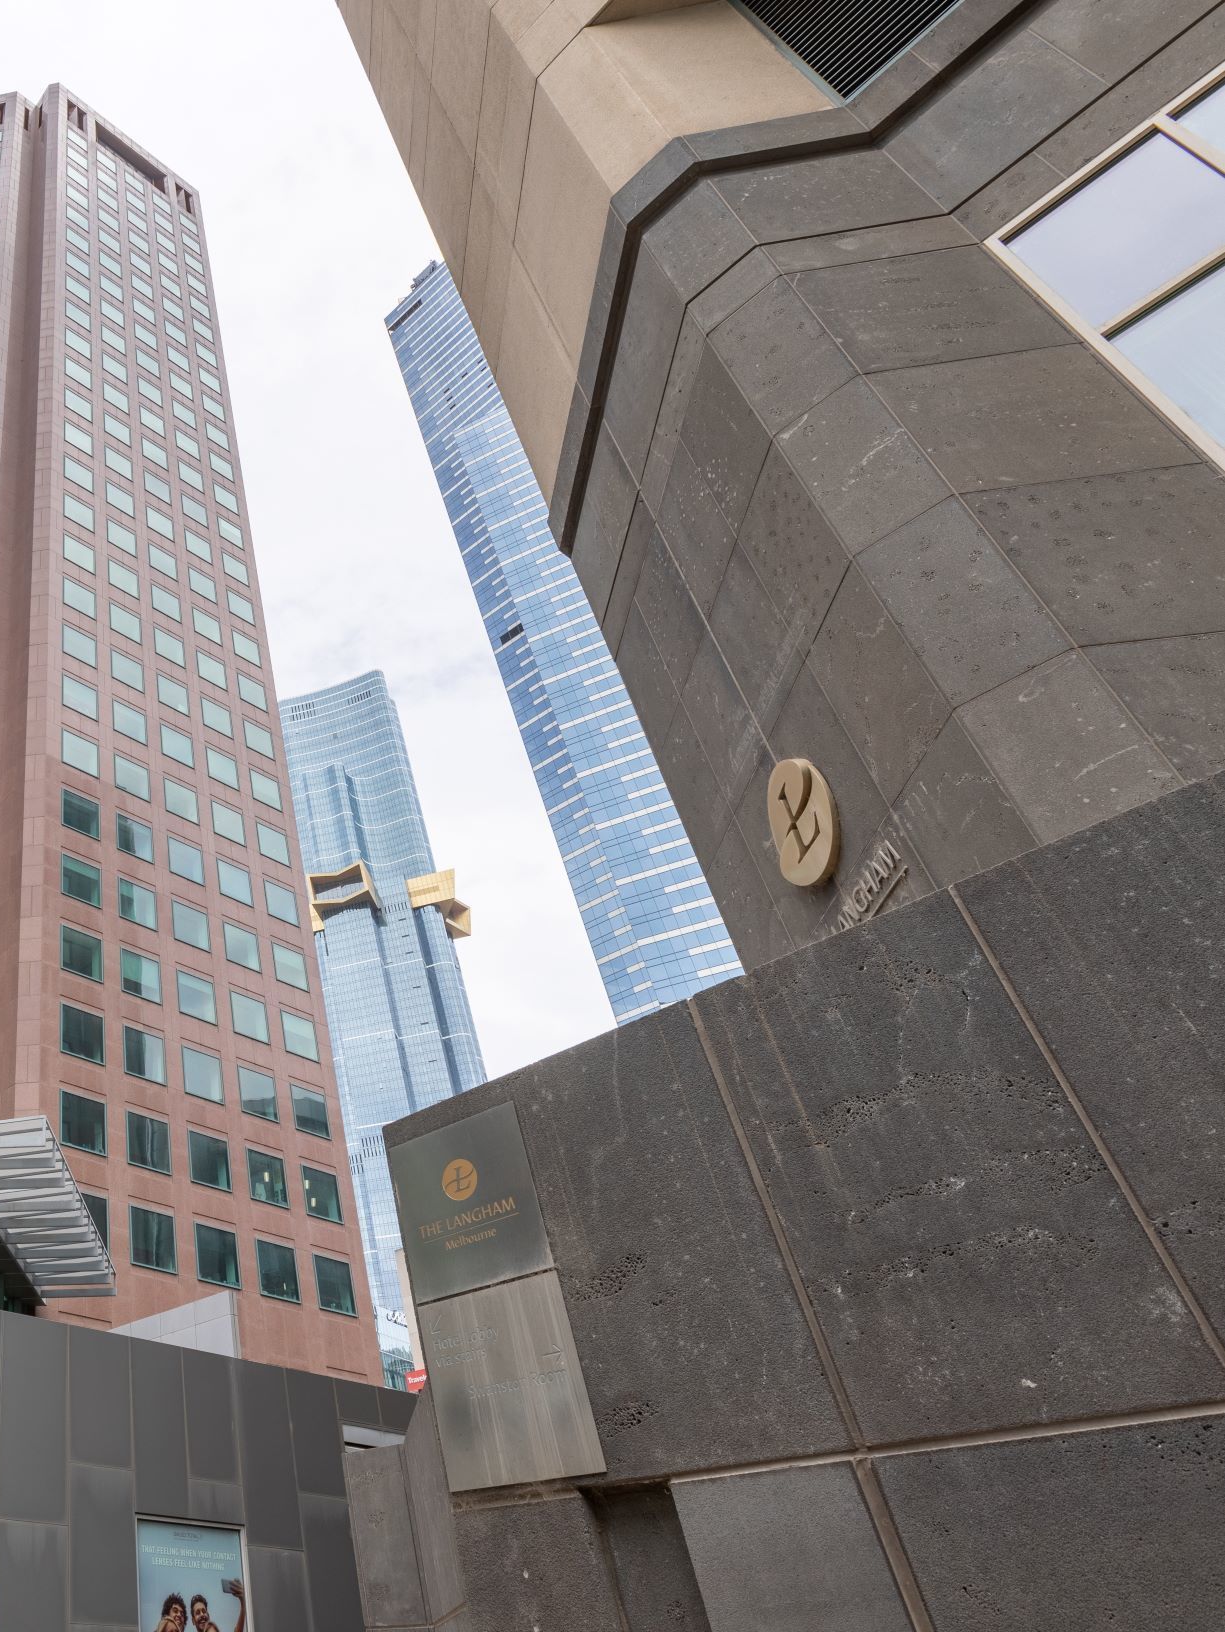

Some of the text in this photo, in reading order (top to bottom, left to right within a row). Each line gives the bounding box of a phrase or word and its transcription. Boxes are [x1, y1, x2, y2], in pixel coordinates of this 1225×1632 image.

[830, 840, 902, 934] ANGHAM
[418, 1196, 516, 1239] THE LANGHAM
[444, 1227, 497, 1250] Melbourne
[433, 1335, 463, 1351] Hotel
[529, 1369, 567, 1385] Room
[142, 1544, 156, 1553] THAT
[181, 1548, 196, 1557] WHEN
[198, 1550, 212, 1559] YOUR
[213, 1552, 236, 1561] CONTACT
[152, 1557, 225, 1571] LENSES FEEL LIKE NOTHING
